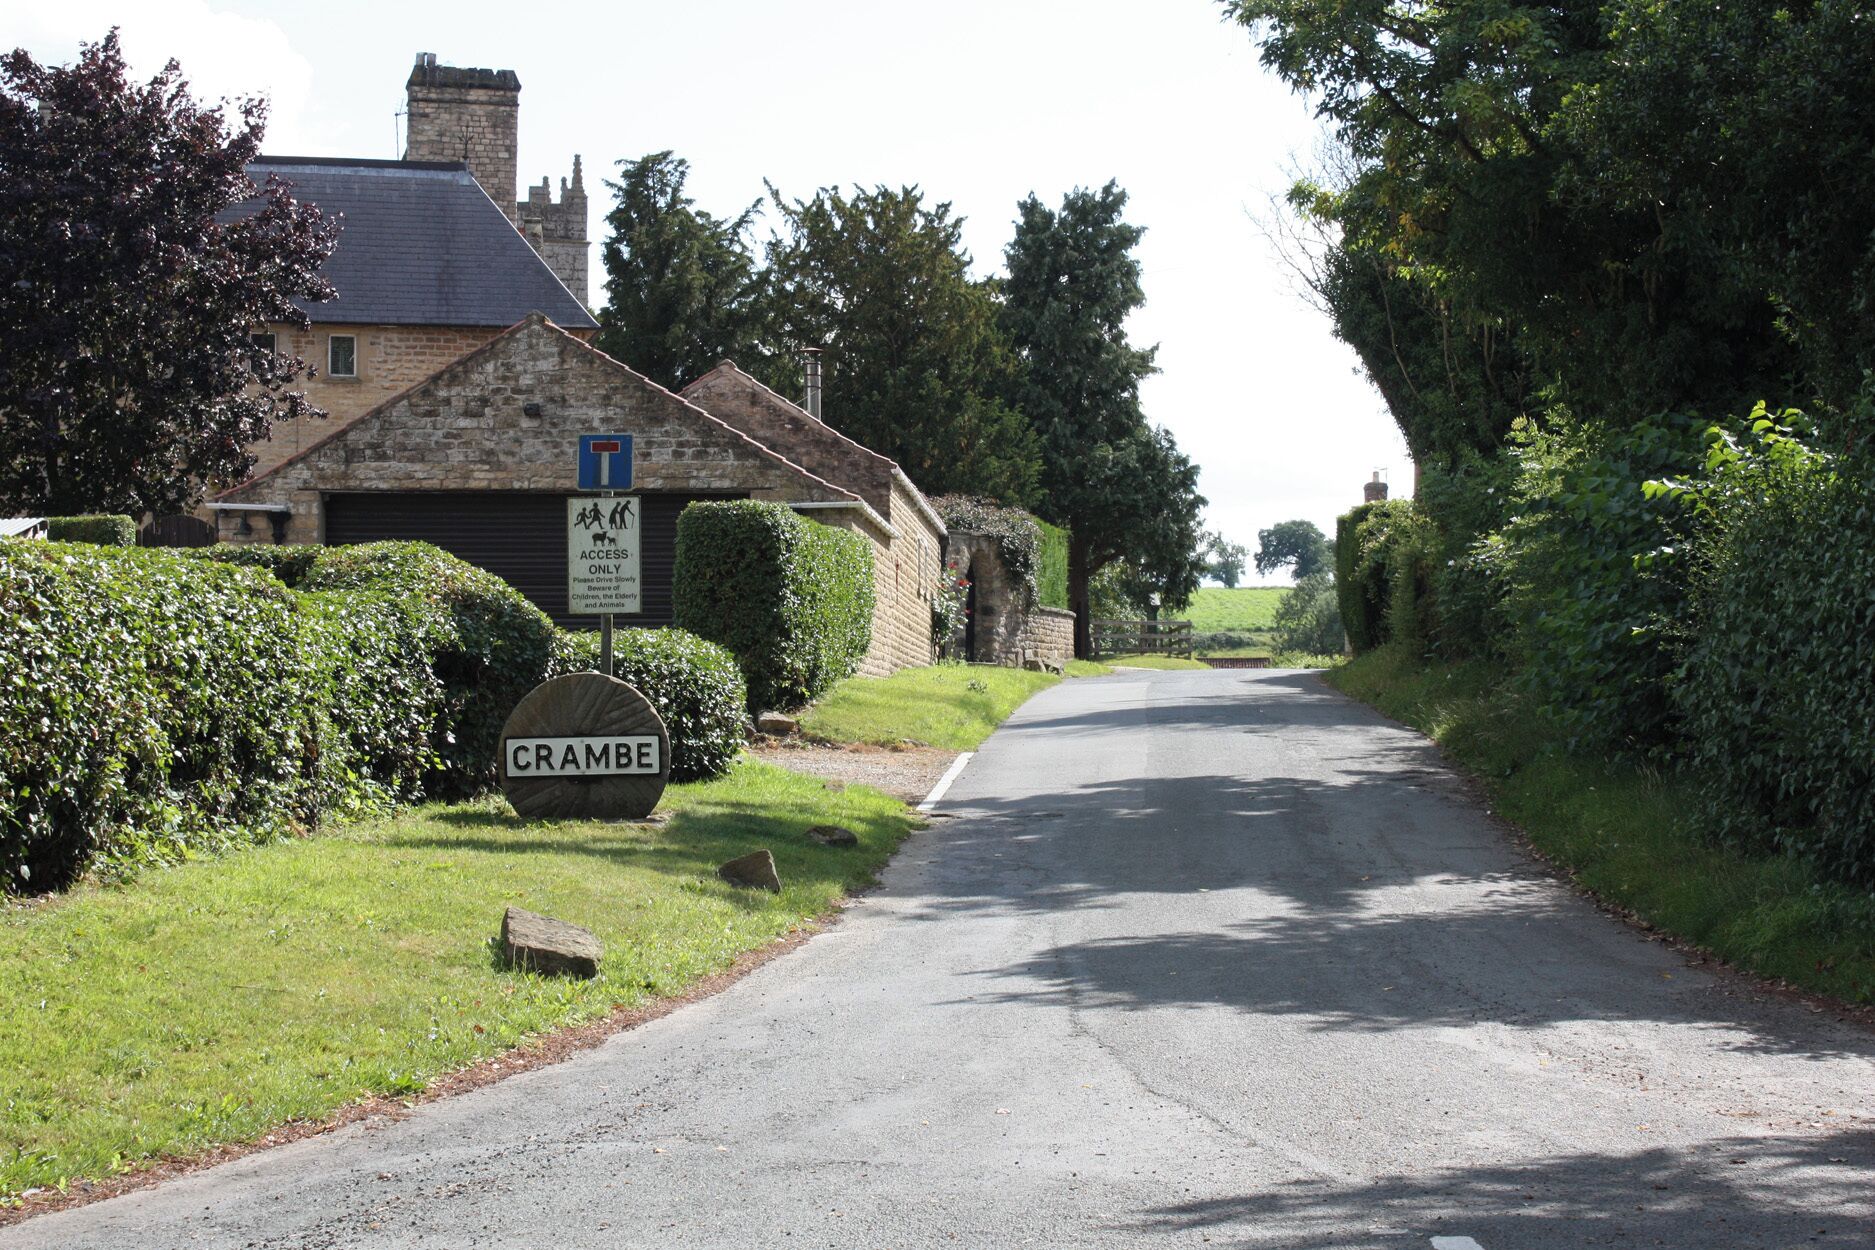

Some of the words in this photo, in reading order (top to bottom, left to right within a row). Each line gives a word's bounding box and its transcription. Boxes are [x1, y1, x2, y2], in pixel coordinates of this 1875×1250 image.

[580, 549, 628, 560] ACCESS
[589, 564, 621, 574] ONLY
[572, 593, 602, 601] Children,
[512, 742, 654, 770] CRAMBE
